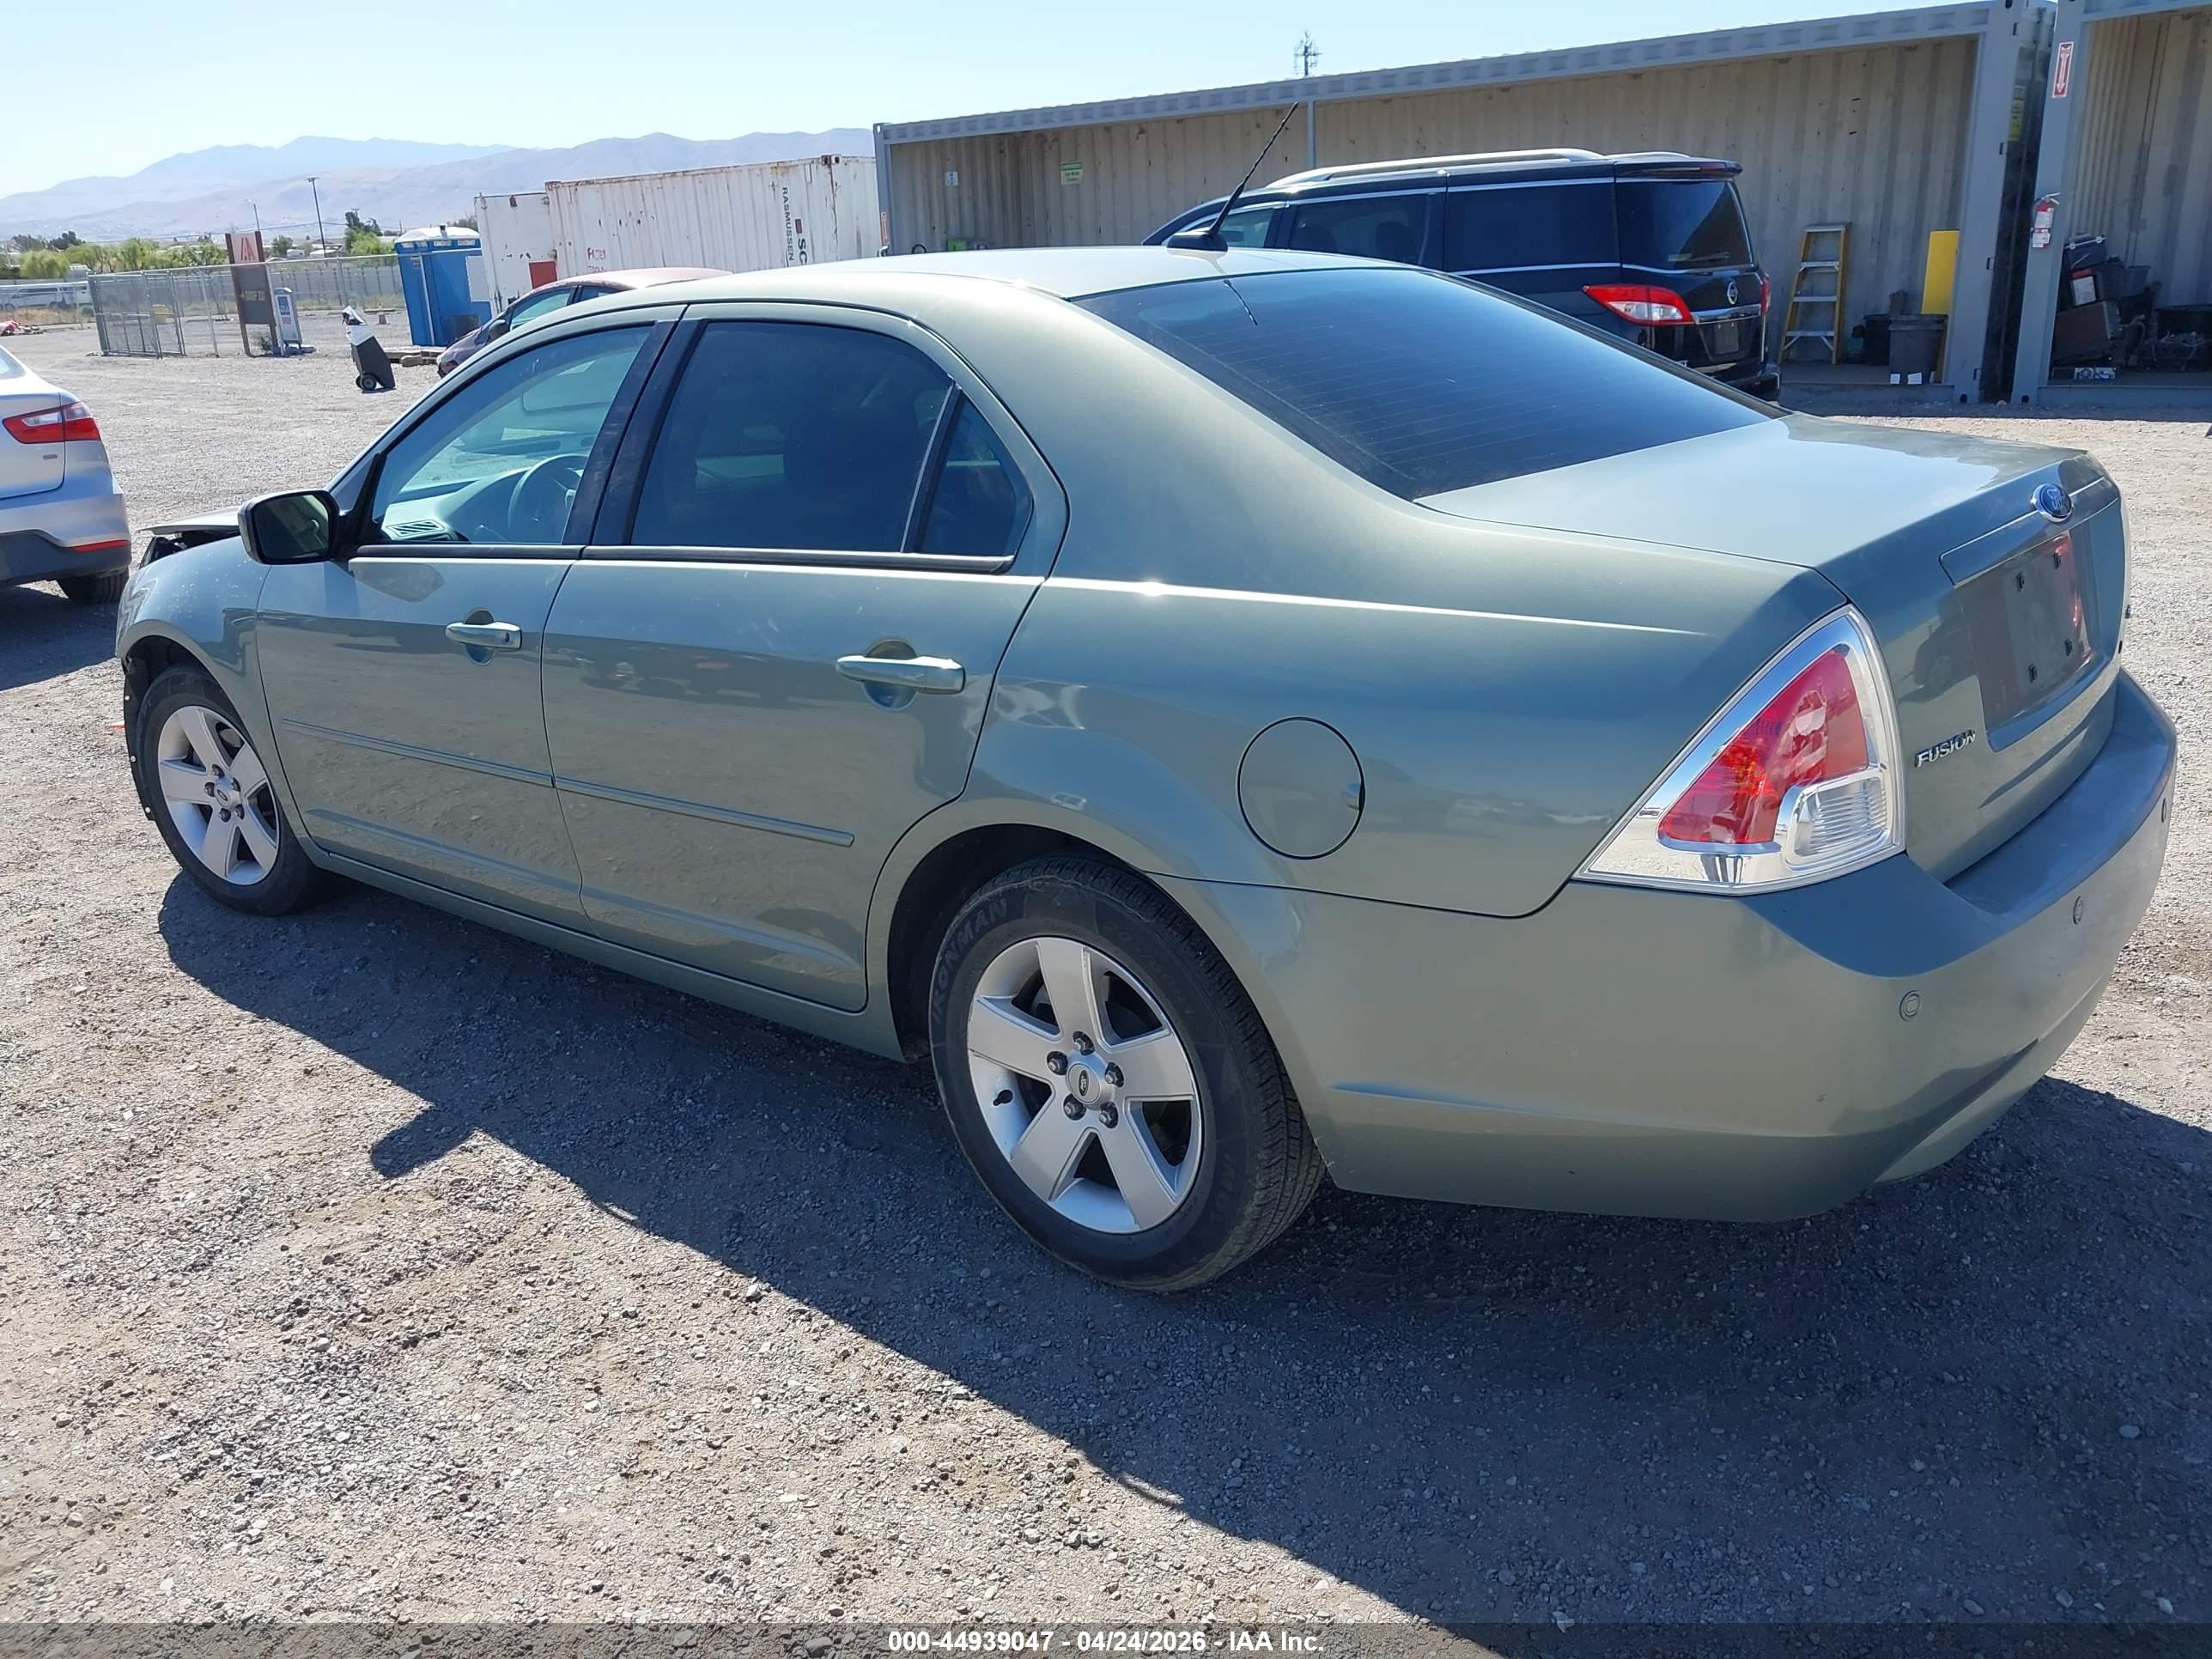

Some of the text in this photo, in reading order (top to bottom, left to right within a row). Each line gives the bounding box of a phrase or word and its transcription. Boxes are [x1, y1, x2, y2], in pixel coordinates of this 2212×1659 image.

[782, 187, 794, 261] RASMUSSEN
[1915, 729, 1976, 769] FUSION
[931, 898, 1008, 1024] IRONMAN
